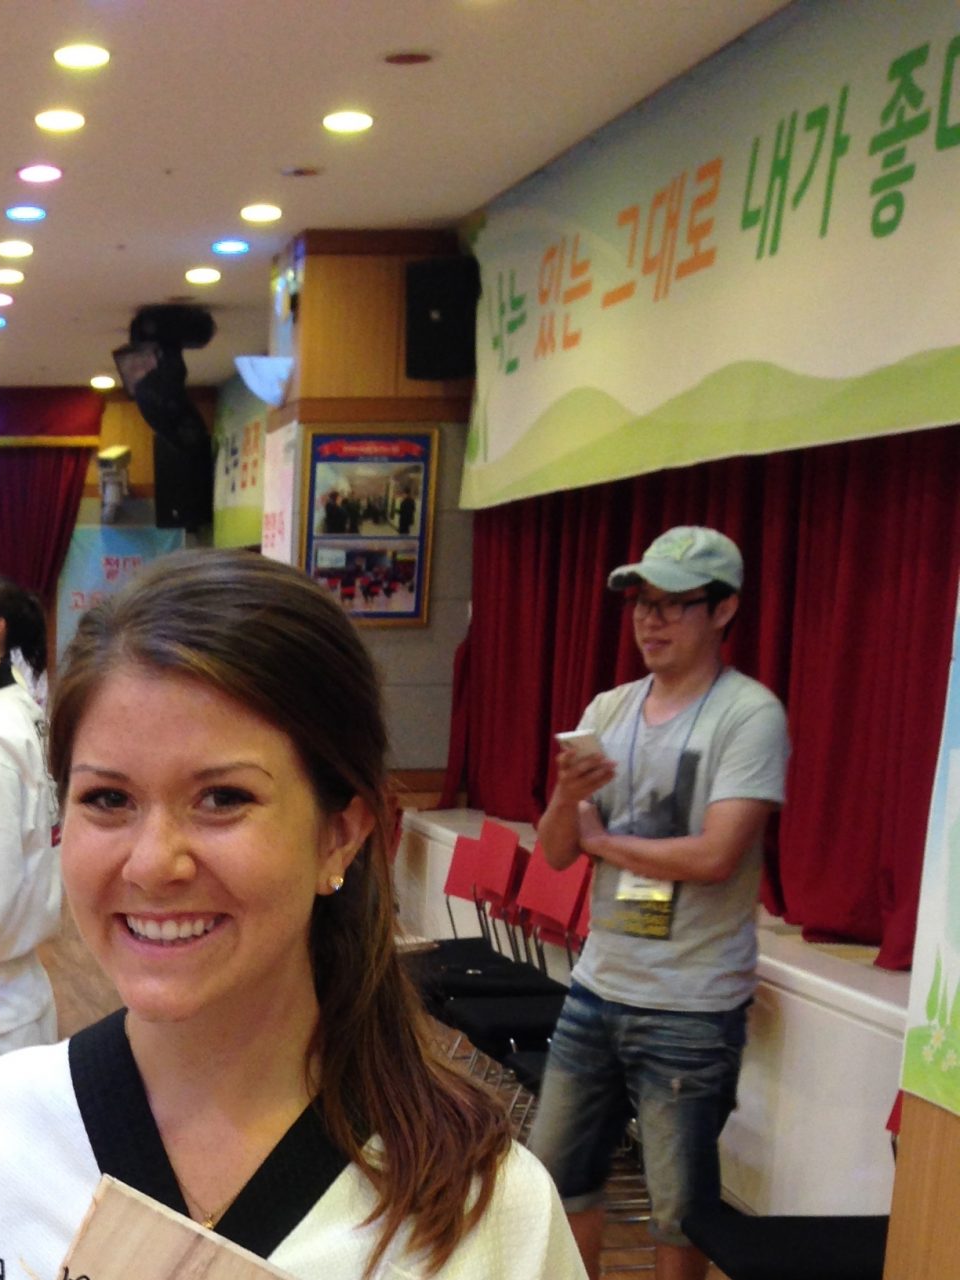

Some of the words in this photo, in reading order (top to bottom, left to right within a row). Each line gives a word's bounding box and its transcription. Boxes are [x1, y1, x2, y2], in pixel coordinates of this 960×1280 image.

[533, 233, 593, 361] 있는
[600, 155, 725, 311] 그대로
[740, 84, 852, 261] 내가
